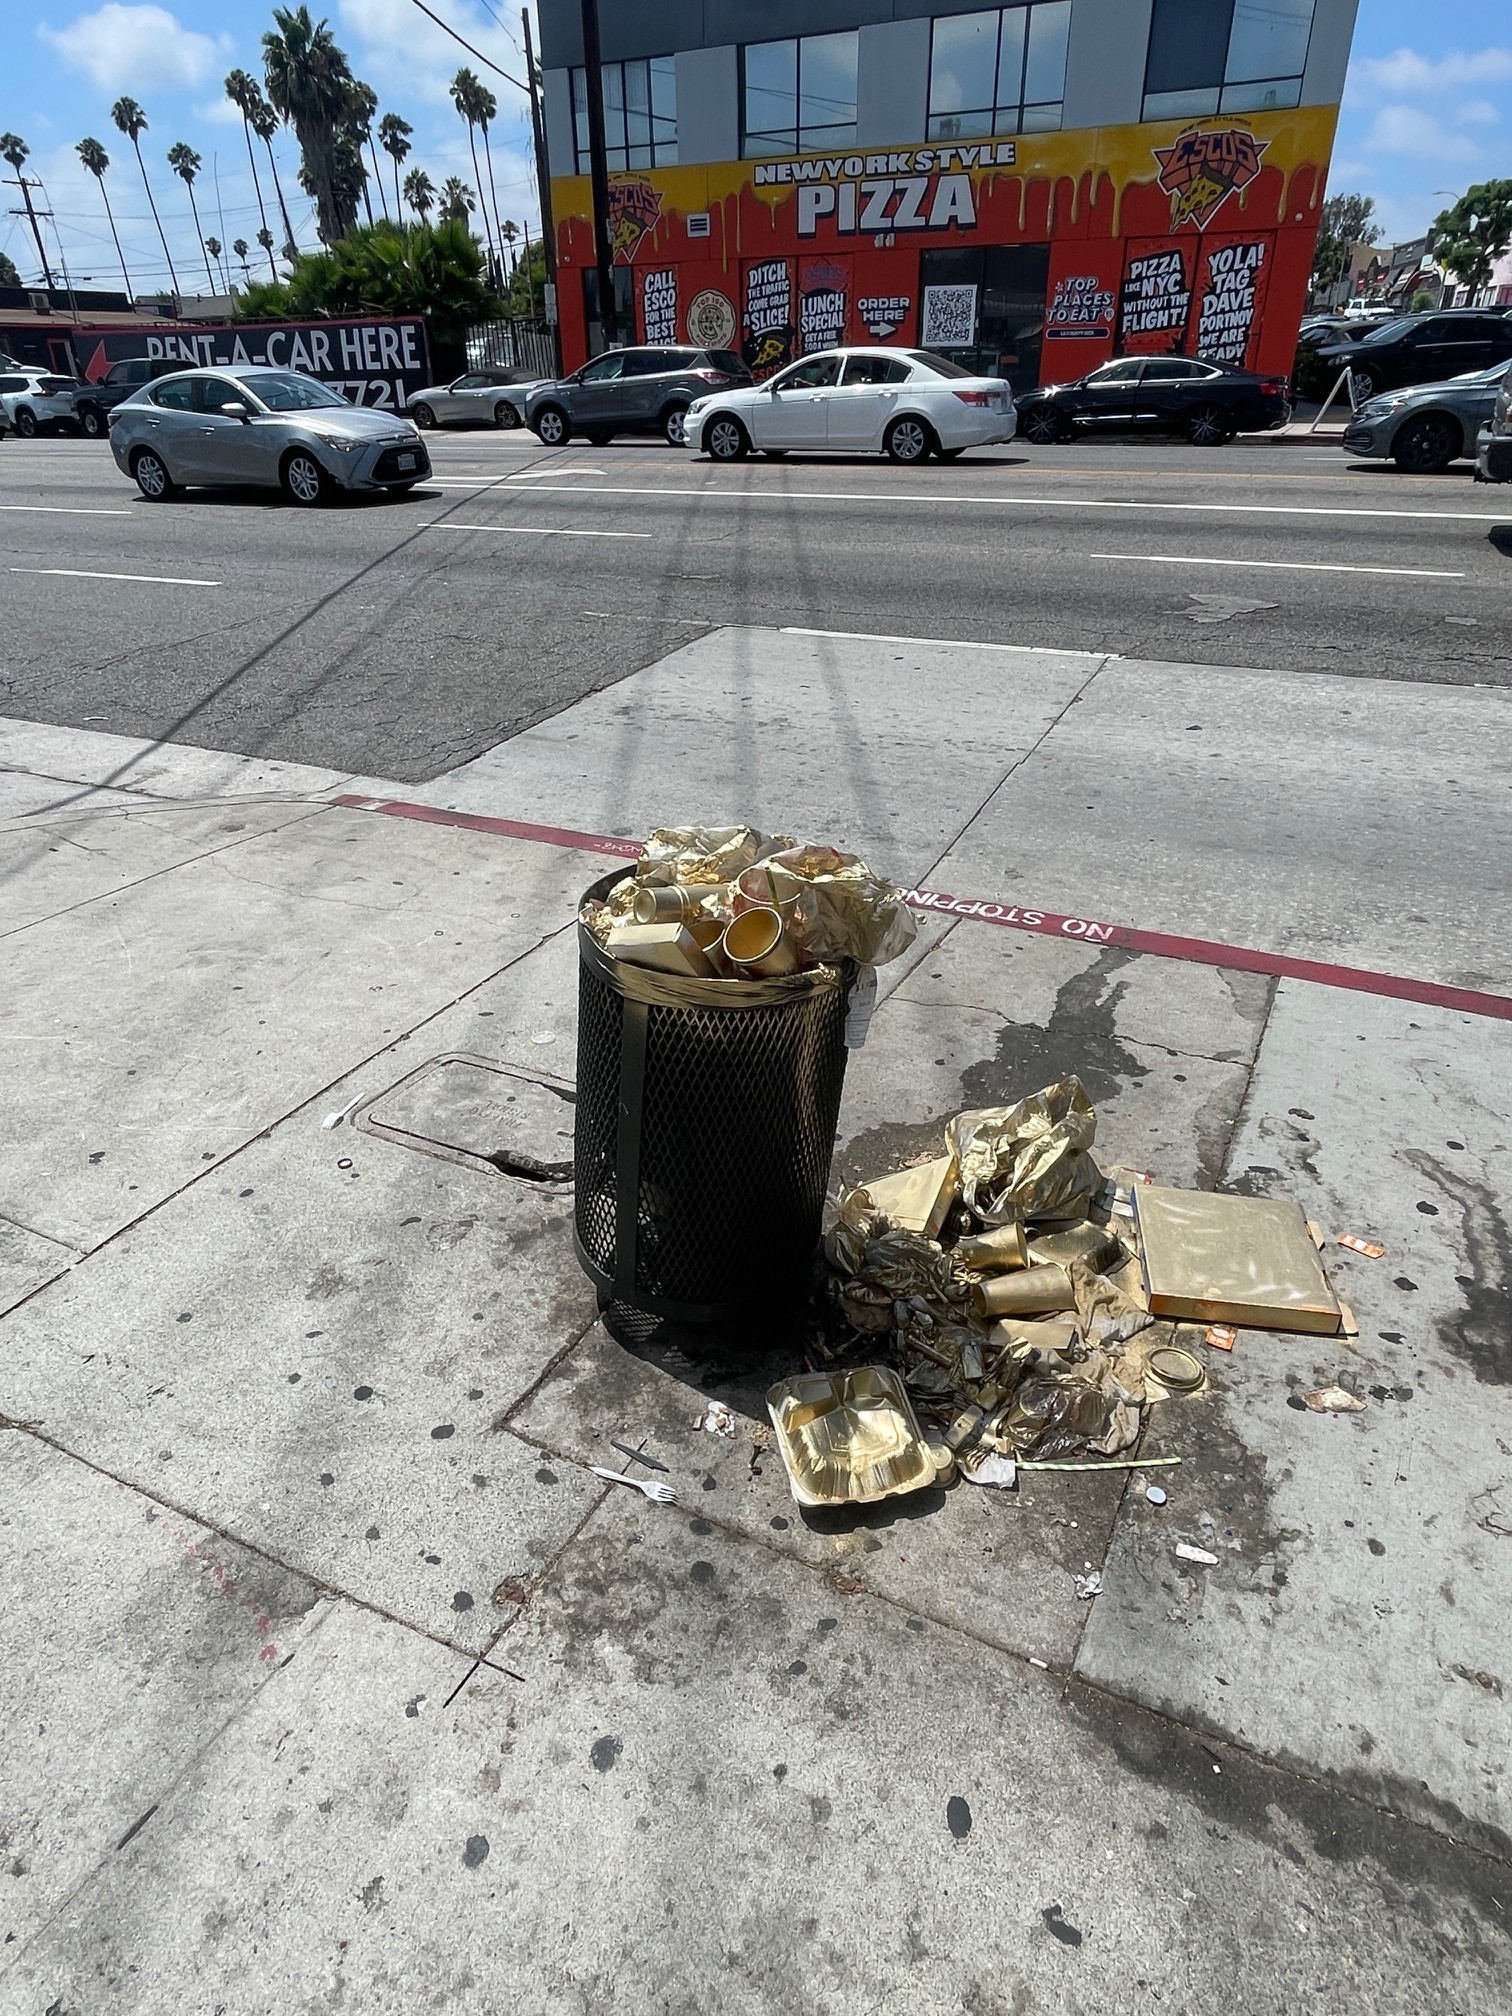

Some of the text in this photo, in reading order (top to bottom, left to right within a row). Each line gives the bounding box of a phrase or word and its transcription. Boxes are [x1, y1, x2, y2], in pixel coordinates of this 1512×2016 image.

[913, 143, 1016, 172] STYLE
[1163, 129, 1258, 173] ESCOS
[797, 174, 977, 238] PIZZA
[1130, 253, 1181, 279] PIZZA
[1208, 243, 1265, 276] YOLA!
[644, 271, 676, 293] CALL
[749, 262, 787, 287] DITCH
[1066, 279, 1096, 291] TOP
[1124, 272, 1181, 297] LIKE NYC
[1213, 270, 1250, 294] TAG
[644, 289, 676, 312] ESCO
[747, 280, 789, 299] THE TRAFFIC
[1054, 293, 1112, 306] PLACES
[748, 293, 790, 312] COME GRAB
[801, 293, 844, 316] LUNCH
[857, 297, 910, 310] ORDER
[1123, 292, 1190, 313] WITHOUT THE
[1203, 287, 1255, 316] DAVE
[645, 307, 676, 324] FOR THE
[743, 304, 790, 331] A SLICE!
[801, 311, 845, 333] SPECIAL
[863, 309, 905, 322] HERE
[1048, 308, 1100, 322] TO EAT
[1122, 306, 1188, 333] FLIGHT!
[1199, 308, 1254, 333] PORTNOY
[645, 320, 676, 340] BEST
[1198, 327, 1246, 347] WE ARE
[340, 325, 421, 371] HERE
[1061, 918, 1114, 942] NO
